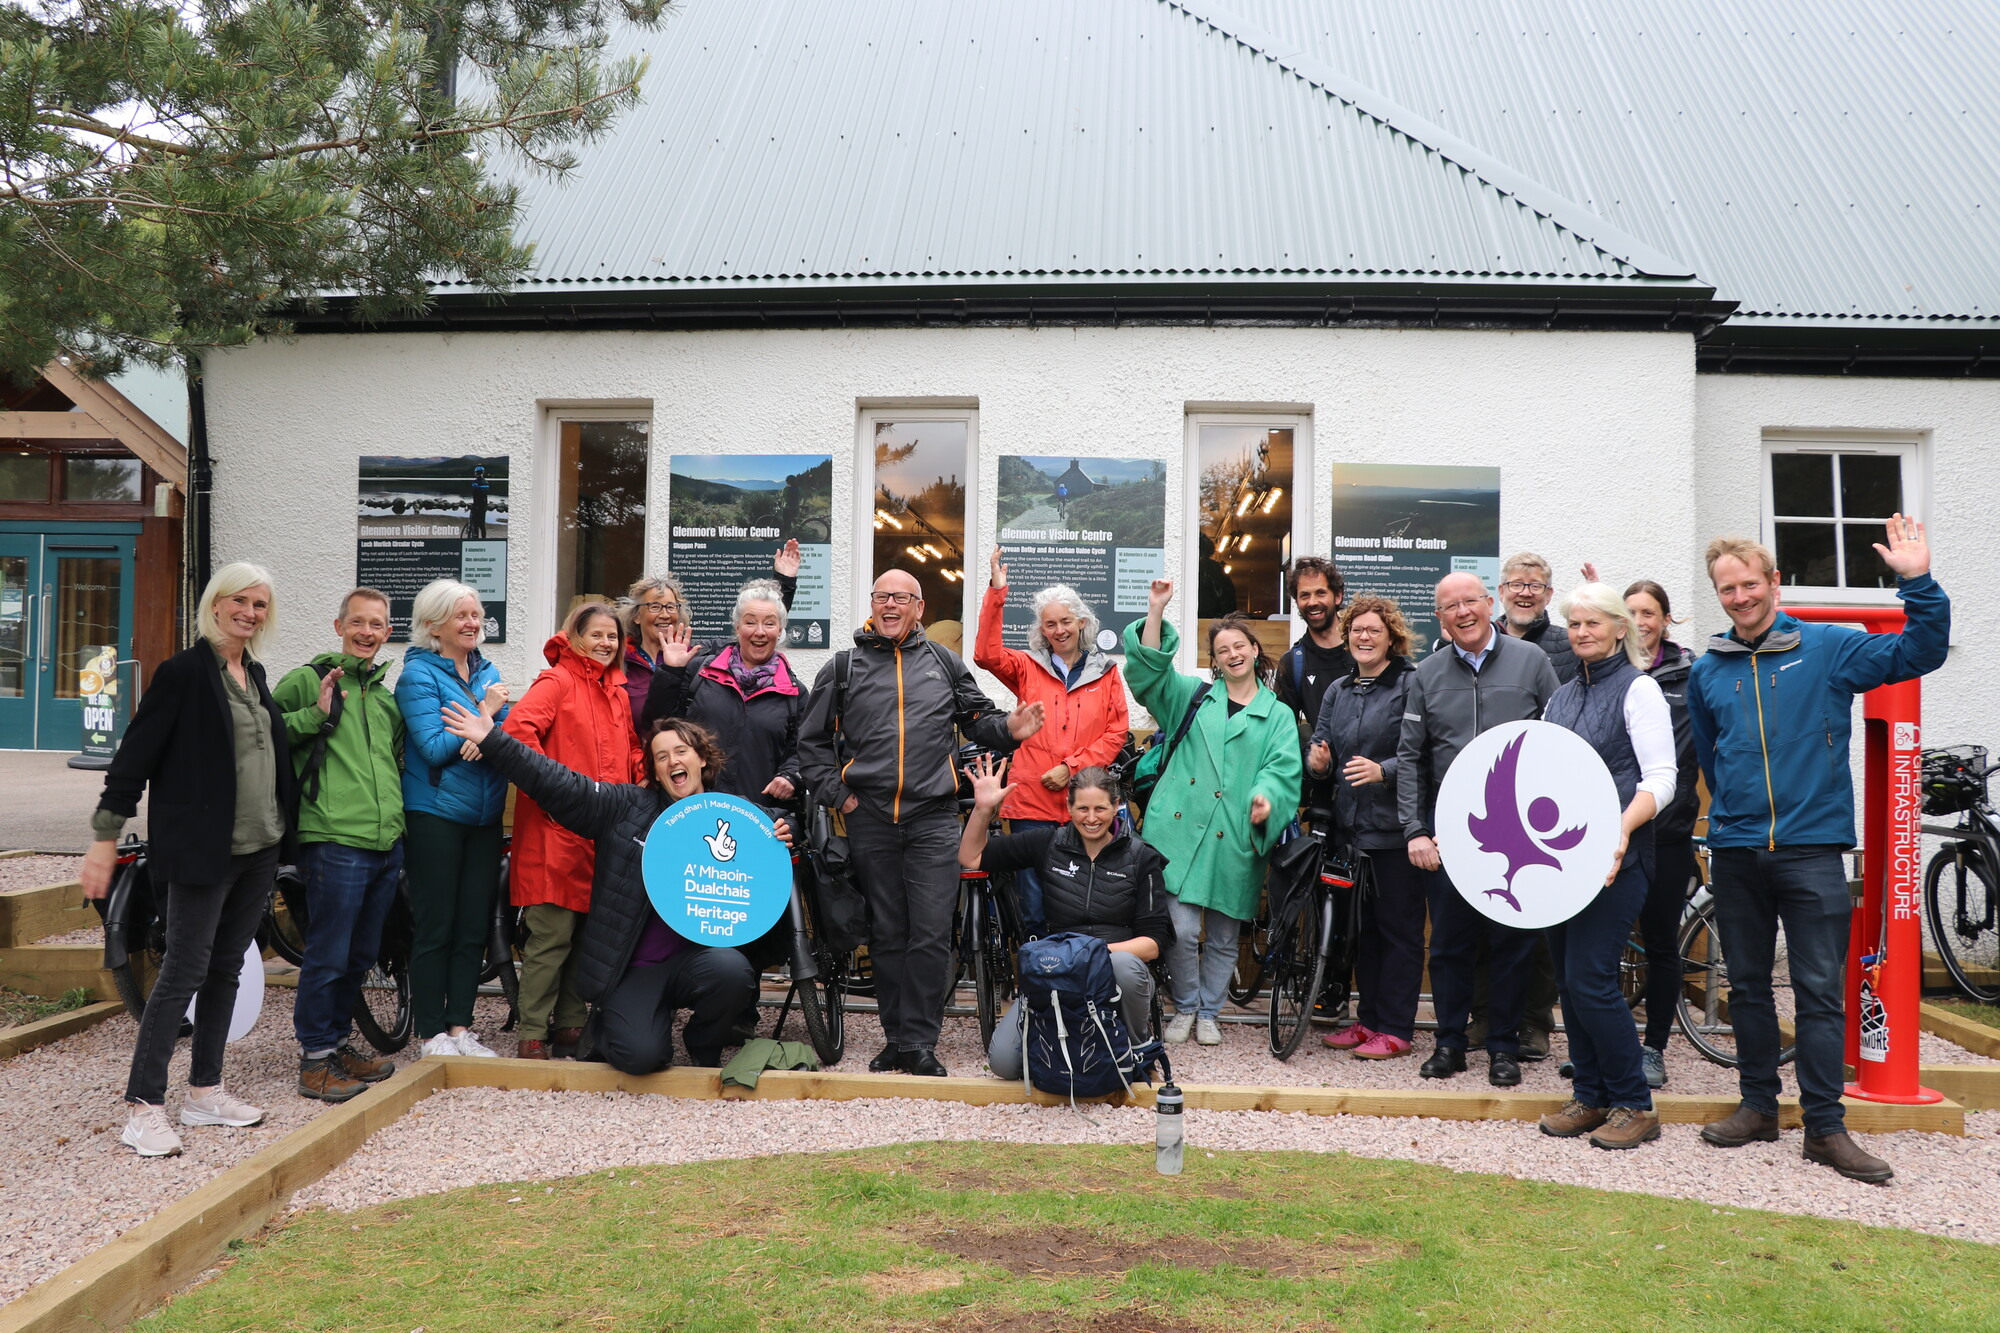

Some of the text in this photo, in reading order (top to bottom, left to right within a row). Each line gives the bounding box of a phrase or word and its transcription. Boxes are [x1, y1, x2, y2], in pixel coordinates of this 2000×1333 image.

[361, 525, 459, 536] Glenmore Visitor Centre
[673, 526, 780, 537] Glenmore Visitor Centre
[1002, 528, 1112, 541] Glenmore Visitor Centre
[1335, 536, 1447, 550] Glenmore Visitor Centre
[88, 694, 109, 705] WE ARE
[84, 706, 113, 731] OPEN
[665, 803, 702, 826] Taing dhan
[710, 800, 773, 838] Made possible with
[1895, 755, 1910, 920] INFRASTRUCTURE
[684, 864, 753, 882] A' Mhaoin-
[685, 880, 750, 898] Dualchais
[687, 904, 747, 924] Heritage
[700, 922, 733, 936] Fund
